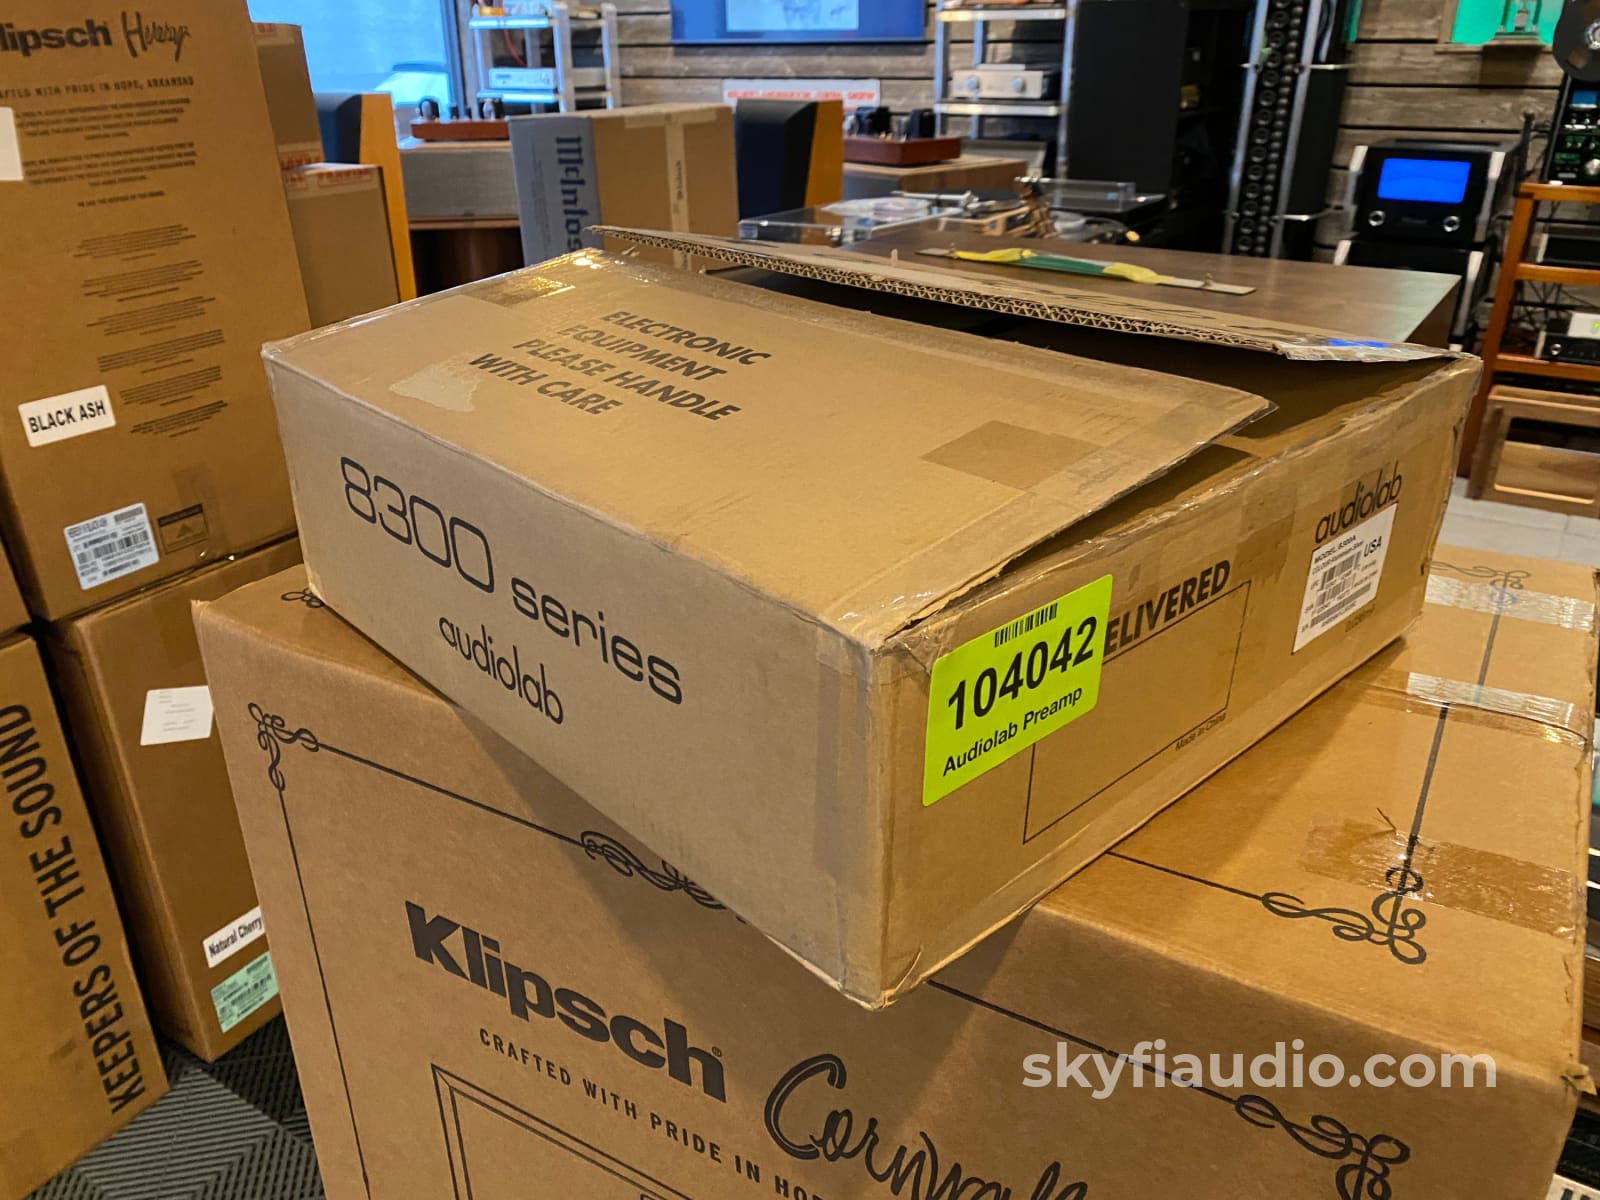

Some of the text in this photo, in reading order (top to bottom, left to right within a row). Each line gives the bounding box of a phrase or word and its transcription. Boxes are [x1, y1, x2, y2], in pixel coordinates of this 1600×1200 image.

[0, 19, 112, 57] lipsch
[556, 136, 590, 251] McIntos
[512, 338, 743, 421] PLEASE HANDLE
[556, 324, 729, 381] EQUIPMENT
[601, 310, 773, 365] ELECTRONIC
[28, 405, 76, 434] BLACK
[79, 400, 107, 422] ASH
[468, 352, 625, 415] WITH CARE
[1315, 460, 1403, 544] audiolab
[341, 457, 683, 705] 8300 series
[1363, 535, 1382, 557] USA
[1104, 559, 1231, 656] ELIVERED
[439, 617, 564, 725] audiolab
[947, 615, 1098, 730] 104042
[942, 687, 1083, 776] Audiolab Preamp
[0, 704, 147, 1115] KEEPERS OF THE SOUND
[208, 917, 262, 957] Natural Cherry
[479, 1028, 825, 1200] CRAFTED WITH PRIDE IN HO
